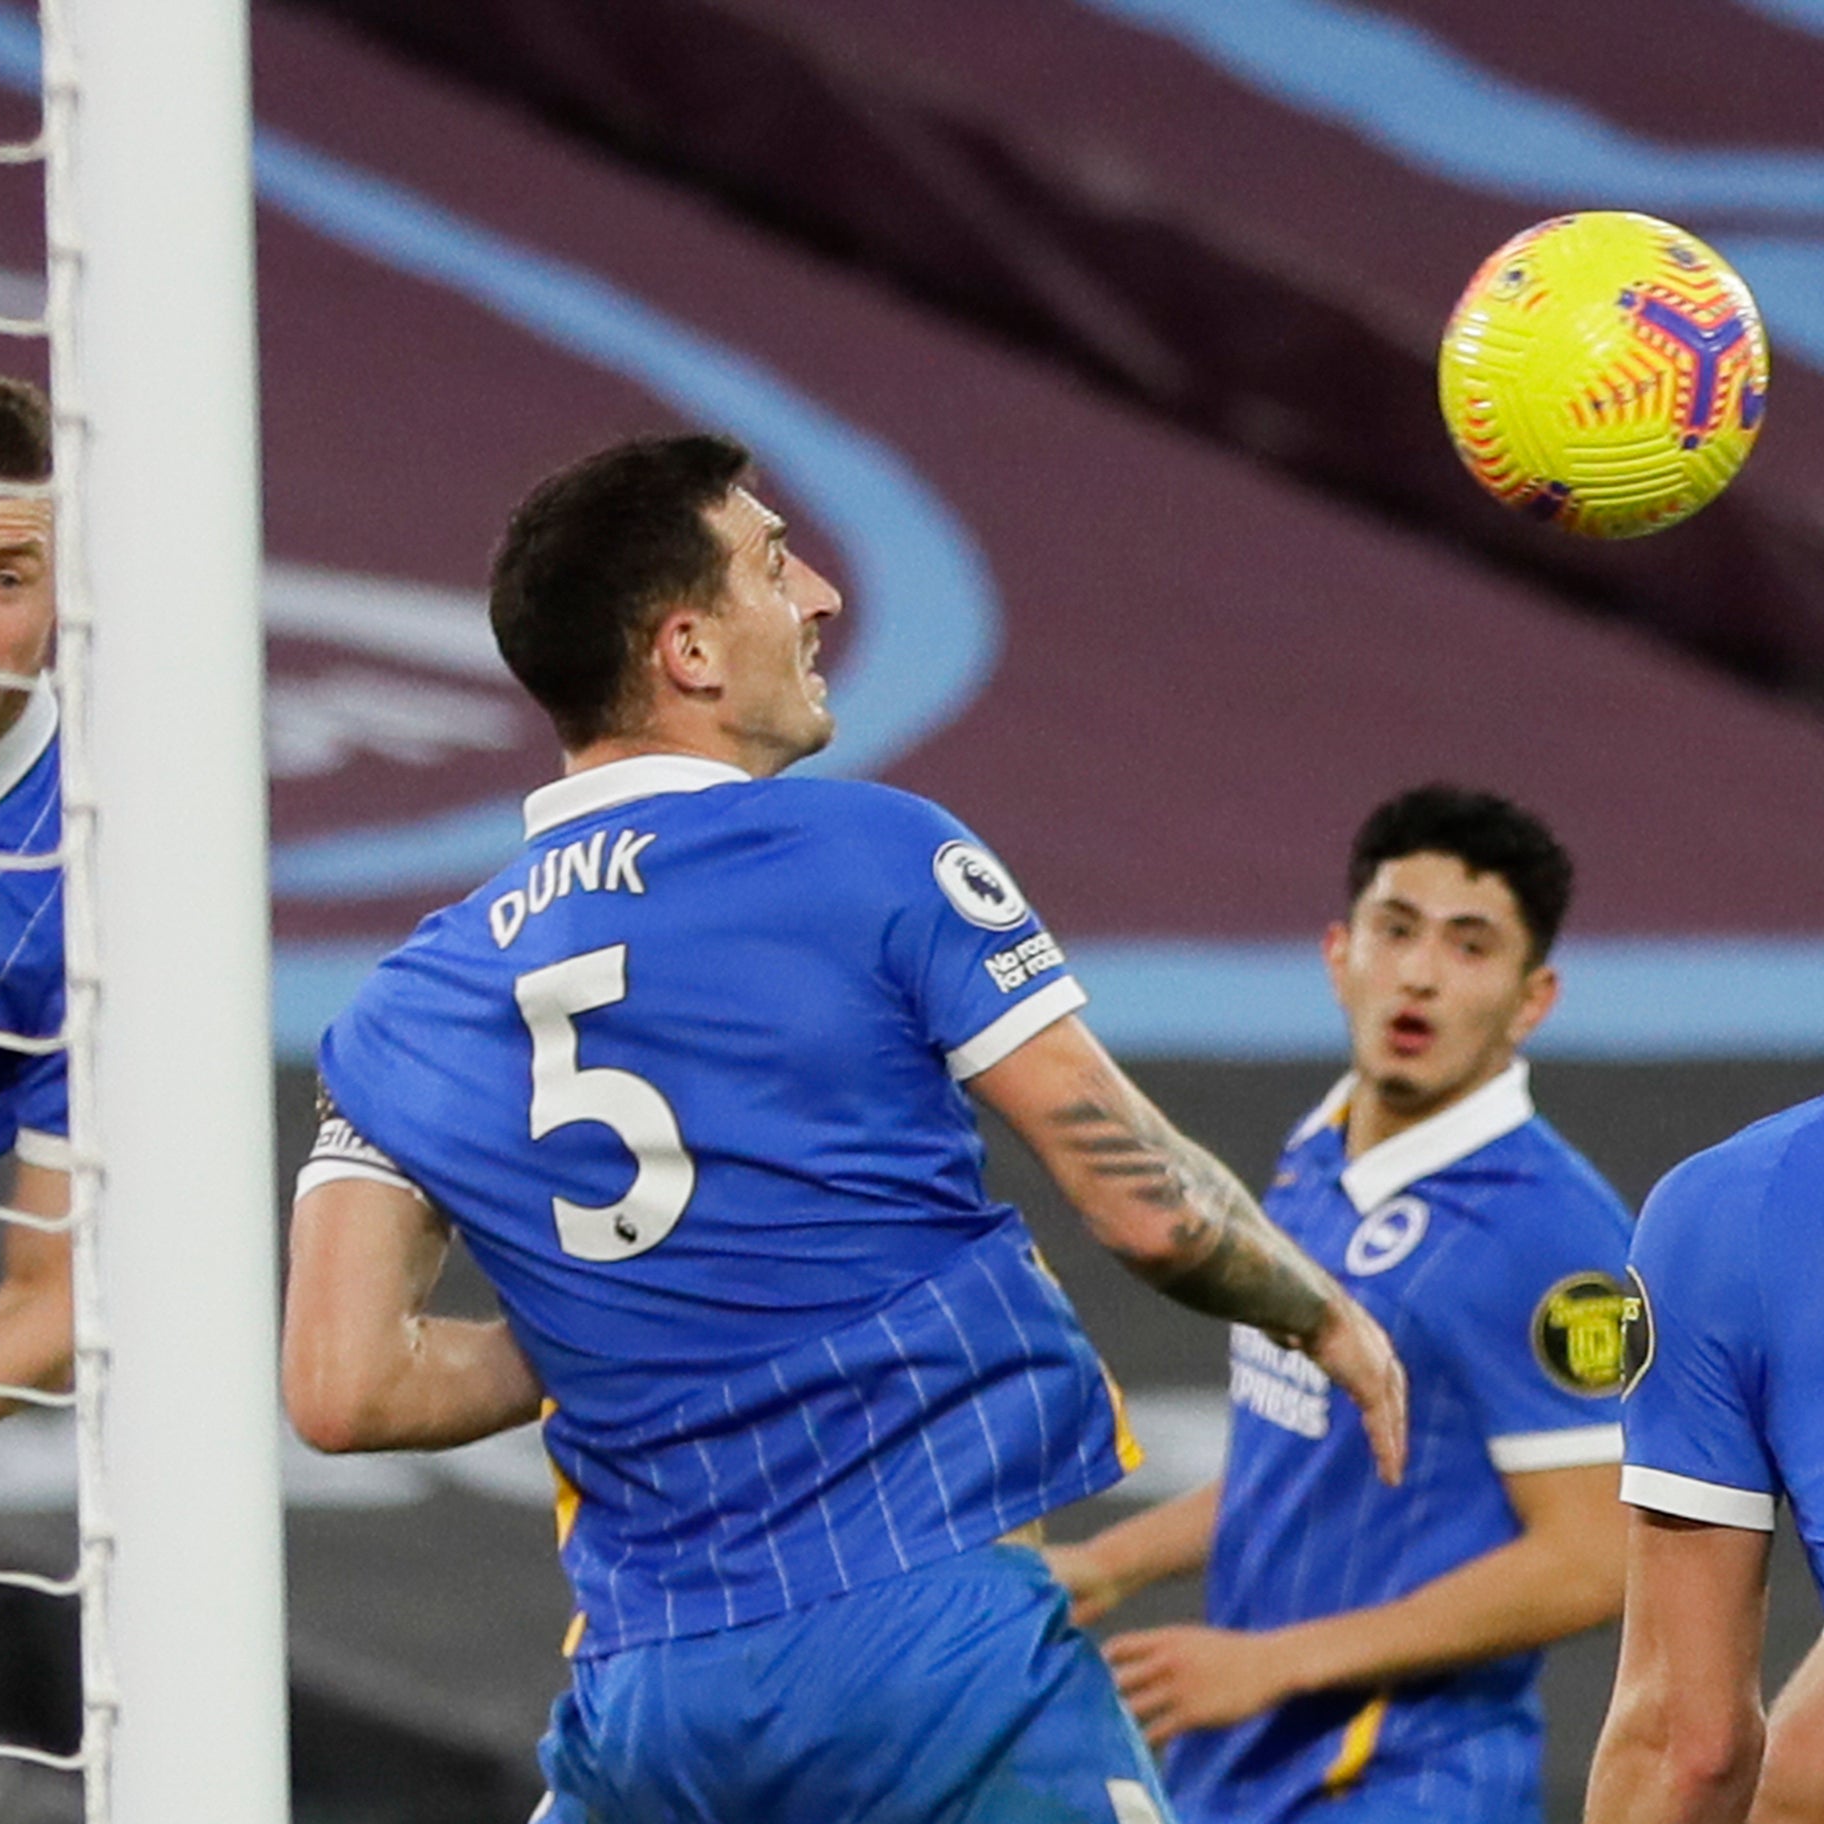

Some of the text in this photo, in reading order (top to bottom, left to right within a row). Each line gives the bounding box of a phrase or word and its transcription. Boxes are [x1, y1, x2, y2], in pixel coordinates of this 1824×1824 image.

[489, 829, 658, 950] DUNK
[983, 951, 1020, 974] No
[513, 942, 696, 1263] 5
